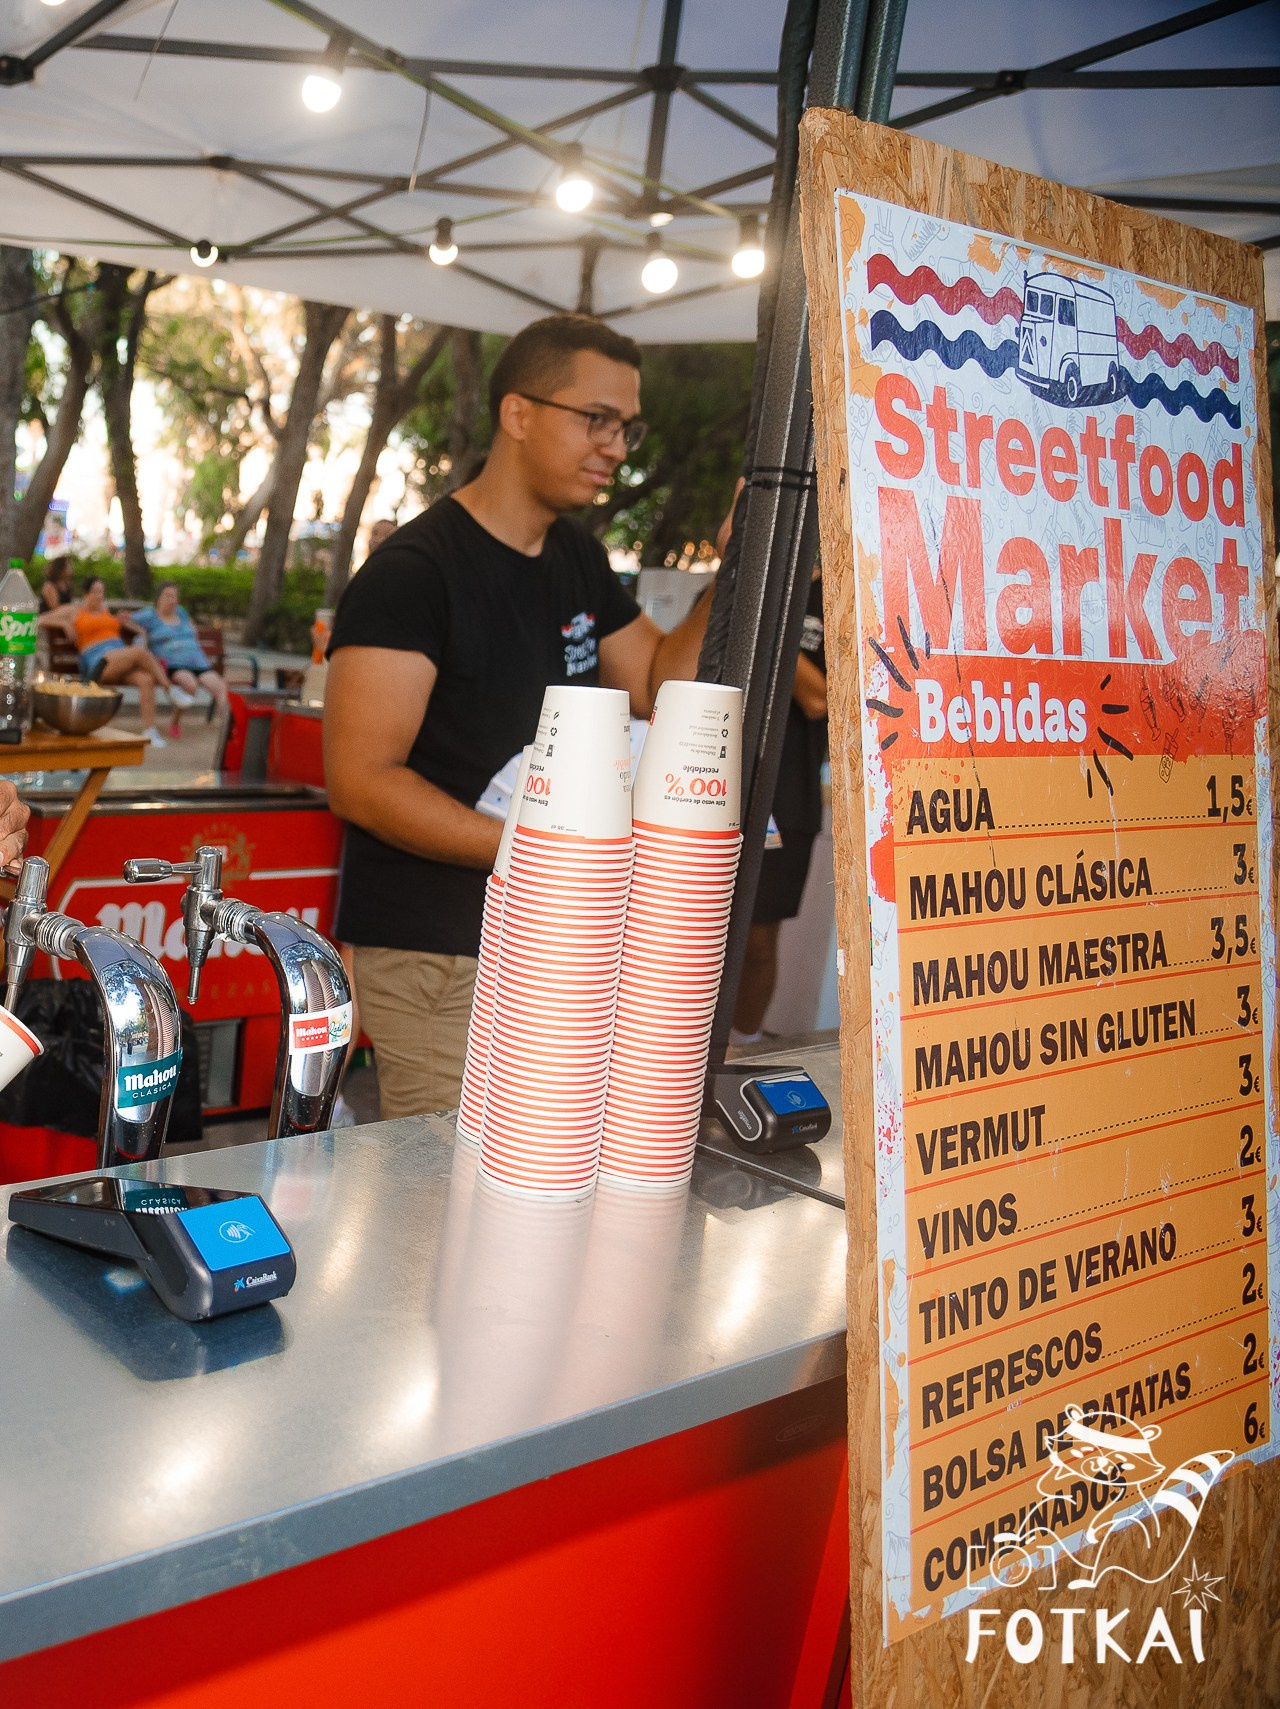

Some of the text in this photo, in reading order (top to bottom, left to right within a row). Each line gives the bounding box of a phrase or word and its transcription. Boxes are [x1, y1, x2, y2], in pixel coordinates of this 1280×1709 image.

[874, 373, 1246, 528] Streetfood
[878, 486, 1254, 664] Market
[914, 678, 1088, 743] Bebidas
[526, 774, 551, 796] 100
[665, 773, 727, 797] 100 %
[682, 765, 719, 774] reciclable
[907, 775, 1253, 835] AGUA 1,5€
[910, 866, 1027, 920] MAHOU
[1035, 849, 1153, 906] CLÁSICA
[913, 915, 1257, 1007] MAHOU MAESTRA 3,5€
[296, 1026, 327, 1037] Mahou
[915, 1028, 1031, 1092] MAHOU
[1040, 1018, 1088, 1066] SIN
[1096, 999, 1196, 1053] GLUTEN
[124, 1065, 177, 1092] Mahou
[916, 1105, 1046, 1176] VERMUT
[917, 1193, 1018, 1261] VINOS
[246, 1270, 278, 1287] CaixaBank
[919, 1276, 1009, 1345] TINTO
[1019, 1260, 1057, 1312] DE
[1065, 1222, 1177, 1294] VERANO
[922, 1322, 1103, 1430] REFRESCOS
[923, 1431, 1027, 1512] BOLSA
[1036, 1408, 1074, 1462] DE
[1082, 1362, 1191, 1434] PATATAS
[924, 1462, 1128, 1592] COMBINADOS
